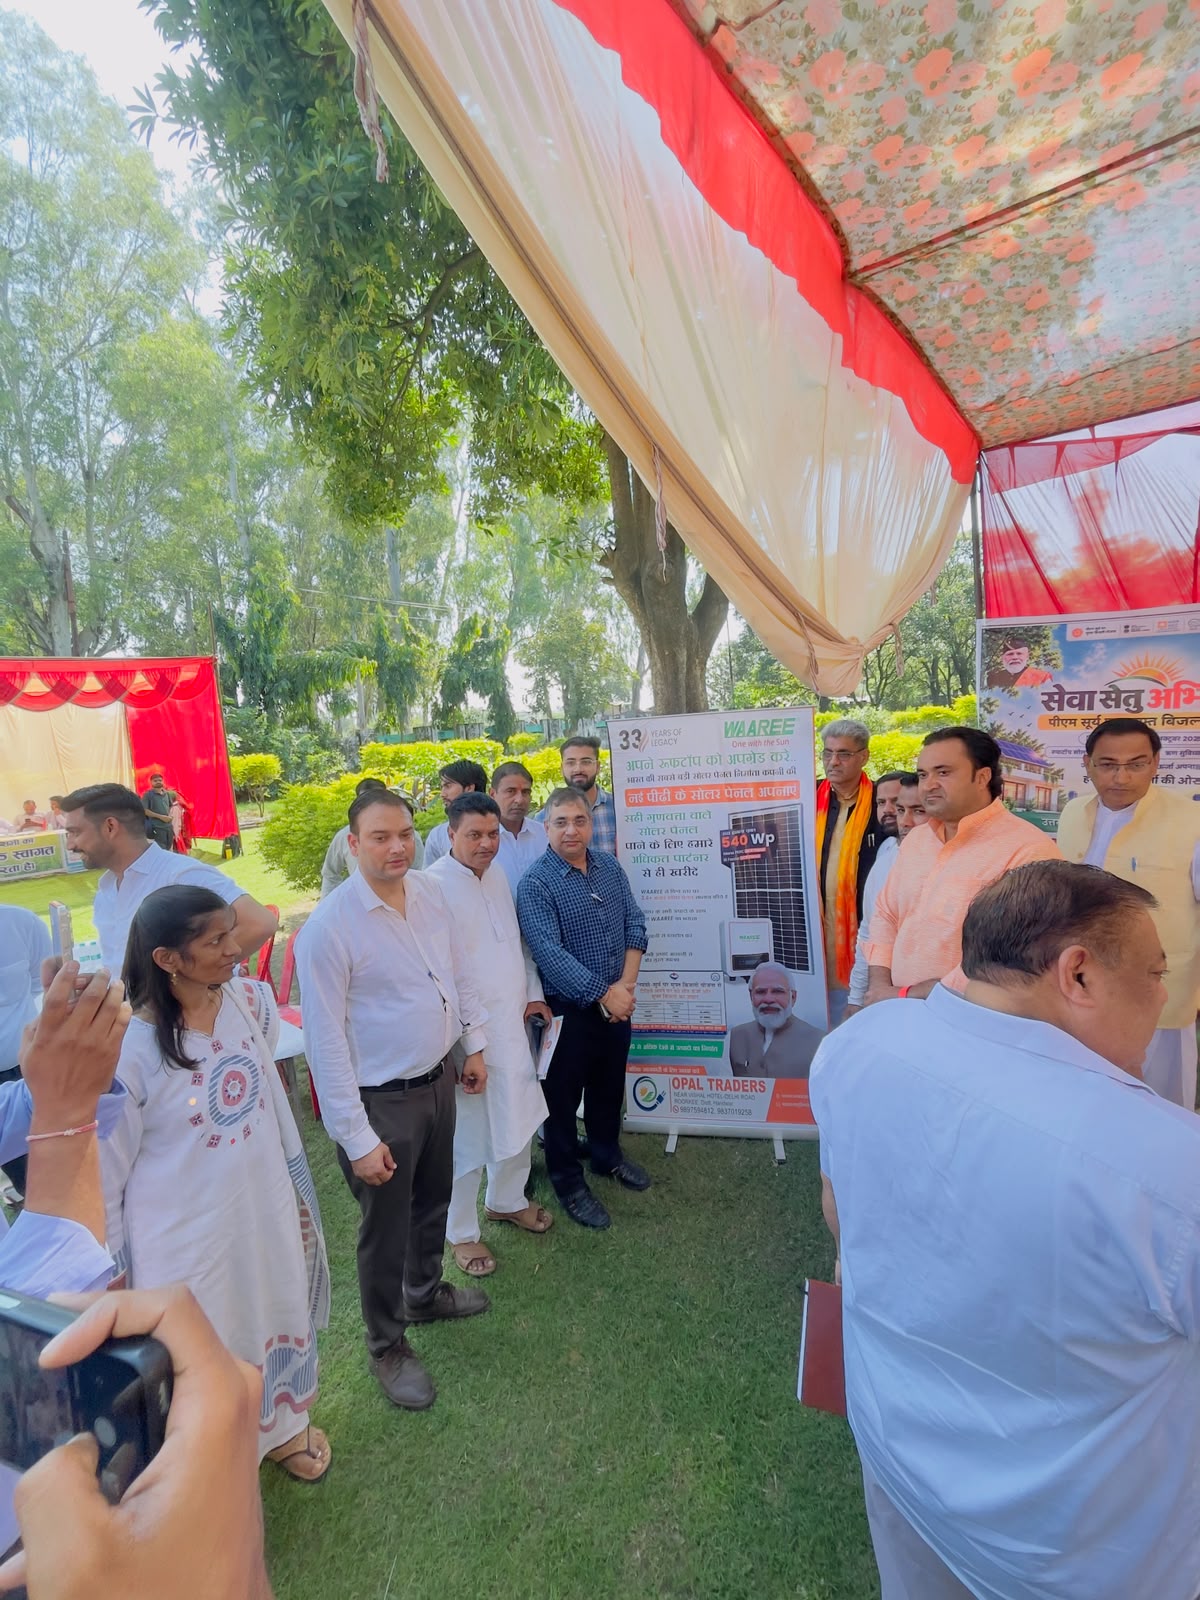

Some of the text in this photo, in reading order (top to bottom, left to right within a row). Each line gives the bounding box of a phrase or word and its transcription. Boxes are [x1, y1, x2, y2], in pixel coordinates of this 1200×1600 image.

[1041, 681, 1200, 713] सेवा सेतु अभि
[724, 718, 796, 738] WAAREE
[1049, 716, 1076, 727] पीएम
[1082, 715, 1102, 729] सूर्य
[673, 728, 682, 736] OF
[619, 729, 642, 749] 33
[651, 738, 678, 746] LEGACY
[732, 740, 746, 748] One
[627, 758, 654, 771] अपने
[706, 754, 722, 766] को
[1161, 774, 1175, 784] की
[675, 790, 686, 801] के
[691, 788, 721, 800] सोलर
[624, 812, 642, 822] सही
[690, 810, 712, 819] वाले
[639, 826, 666, 836] सोलर
[626, 838, 713, 849] पाने के लिए हमारे
[722, 833, 775, 848] 540 Wp
[13, 846, 54, 859] स्वागत
[642, 868, 651, 877] से
[655, 867, 665, 876] ही
[672, 1077, 766, 1092] OPAL TRADERS
